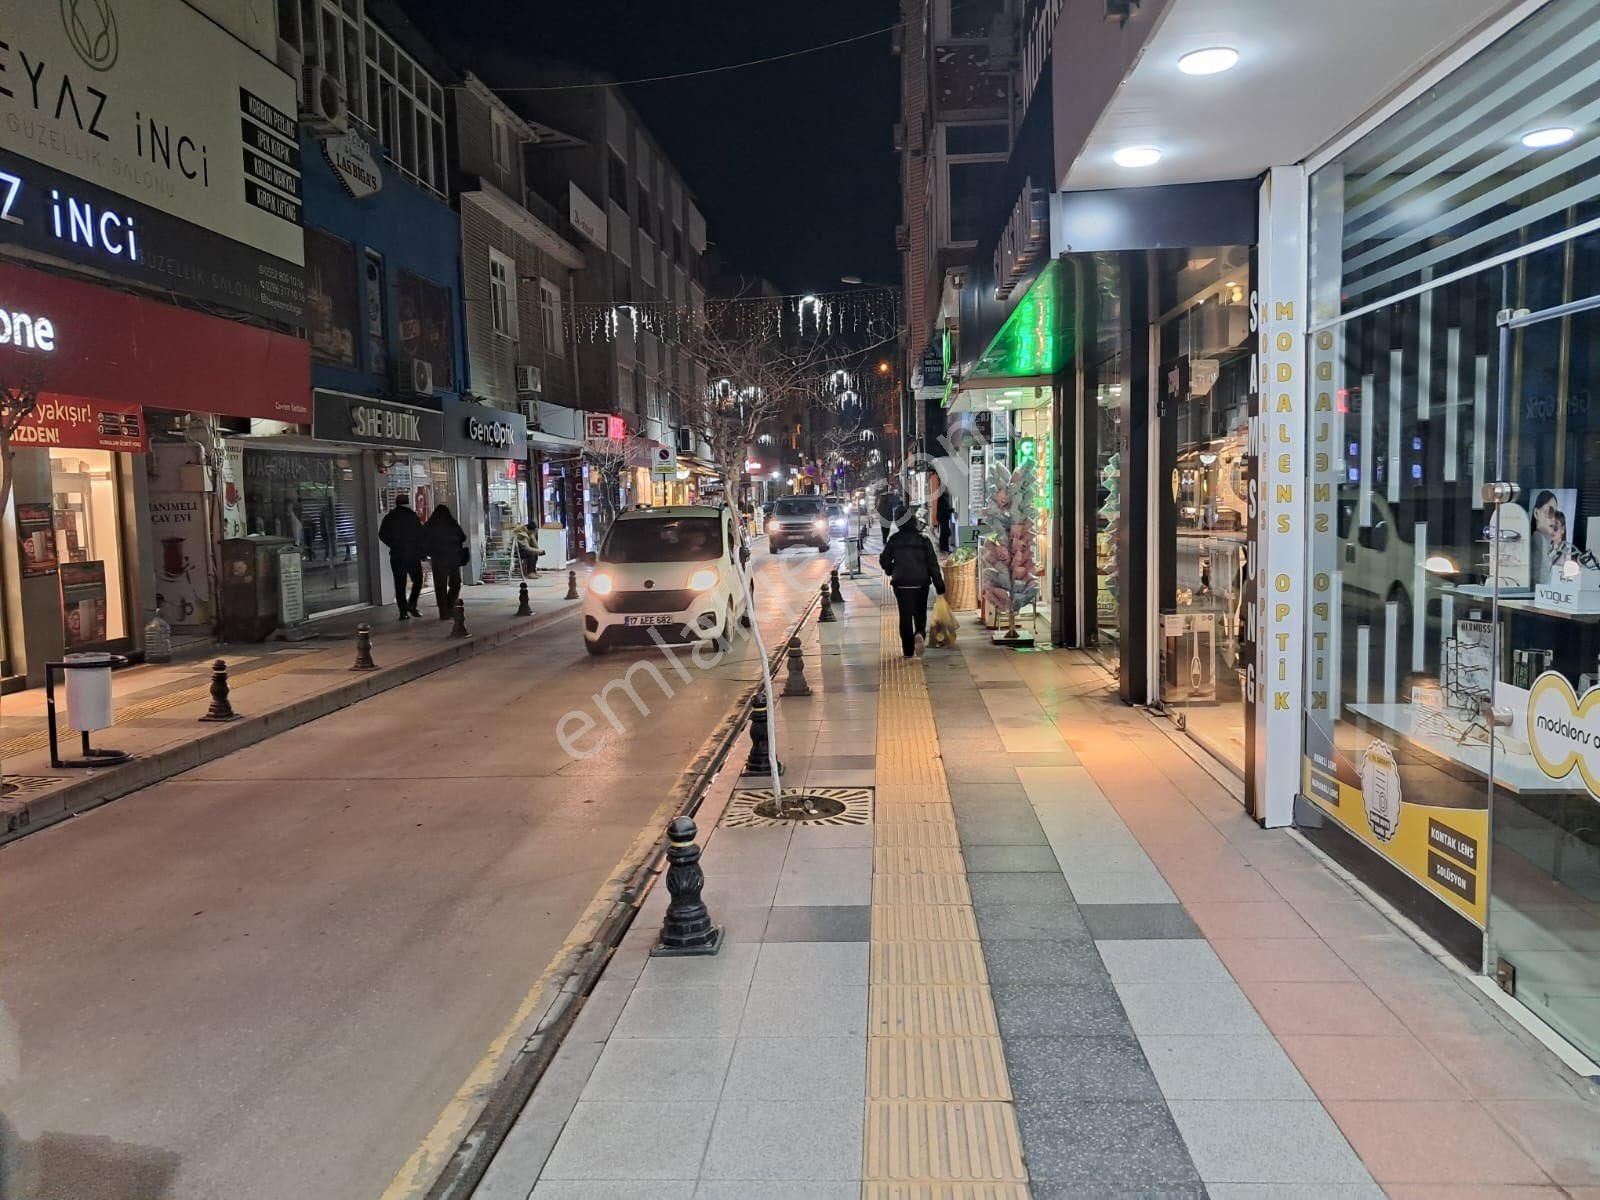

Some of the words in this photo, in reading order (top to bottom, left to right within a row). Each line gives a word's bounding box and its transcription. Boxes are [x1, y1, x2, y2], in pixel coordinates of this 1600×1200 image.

[36, 399, 92, 427] yakışır!
[357, 406, 382, 438] SHE
[1274, 301, 1294, 534] MODALENS
[575, 469, 585, 549] ECZANE
[1246, 289, 1258, 704] SAMSUNG
[630, 616, 638, 625] 17
[1537, 715, 1591, 745] modalens
[1430, 826, 1456, 852] KONTAK
[1457, 838, 1476, 861] LENS
[1435, 863, 1467, 891] SOLÜSYON
